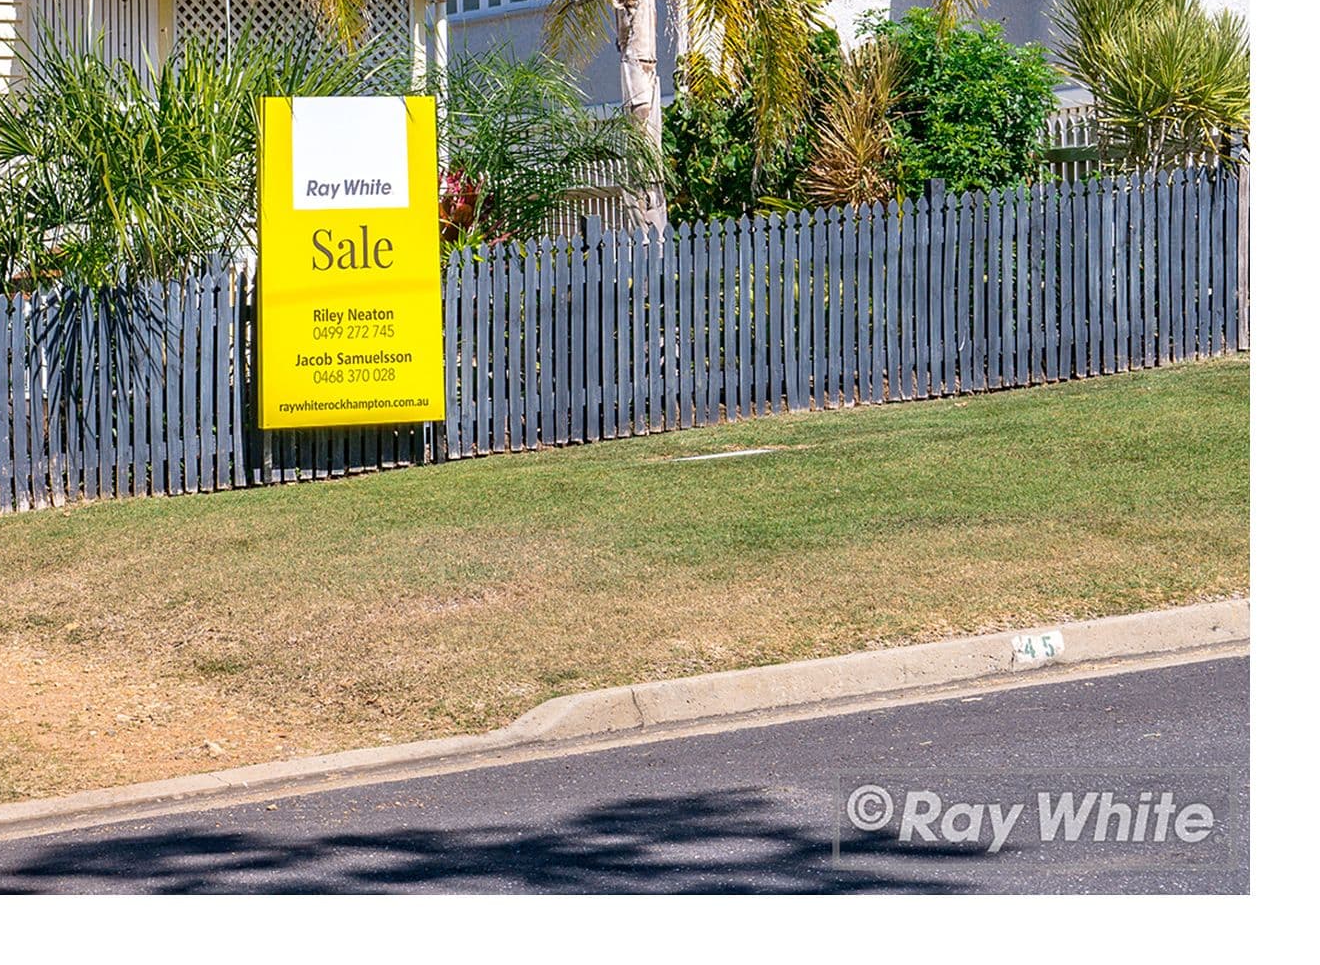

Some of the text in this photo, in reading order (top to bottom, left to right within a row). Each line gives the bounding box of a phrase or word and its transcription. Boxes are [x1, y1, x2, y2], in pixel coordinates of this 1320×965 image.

[306, 178, 392, 200] Ray White
[312, 224, 394, 271] Sale
[313, 308, 394, 325] Riley Neaton
[313, 323, 395, 341] 0499 272 745
[295, 350, 413, 367] Jacob Samuelsson
[313, 367, 396, 385] 0468 370 028
[279, 397, 430, 414] raywhiterockhampton.com.au
